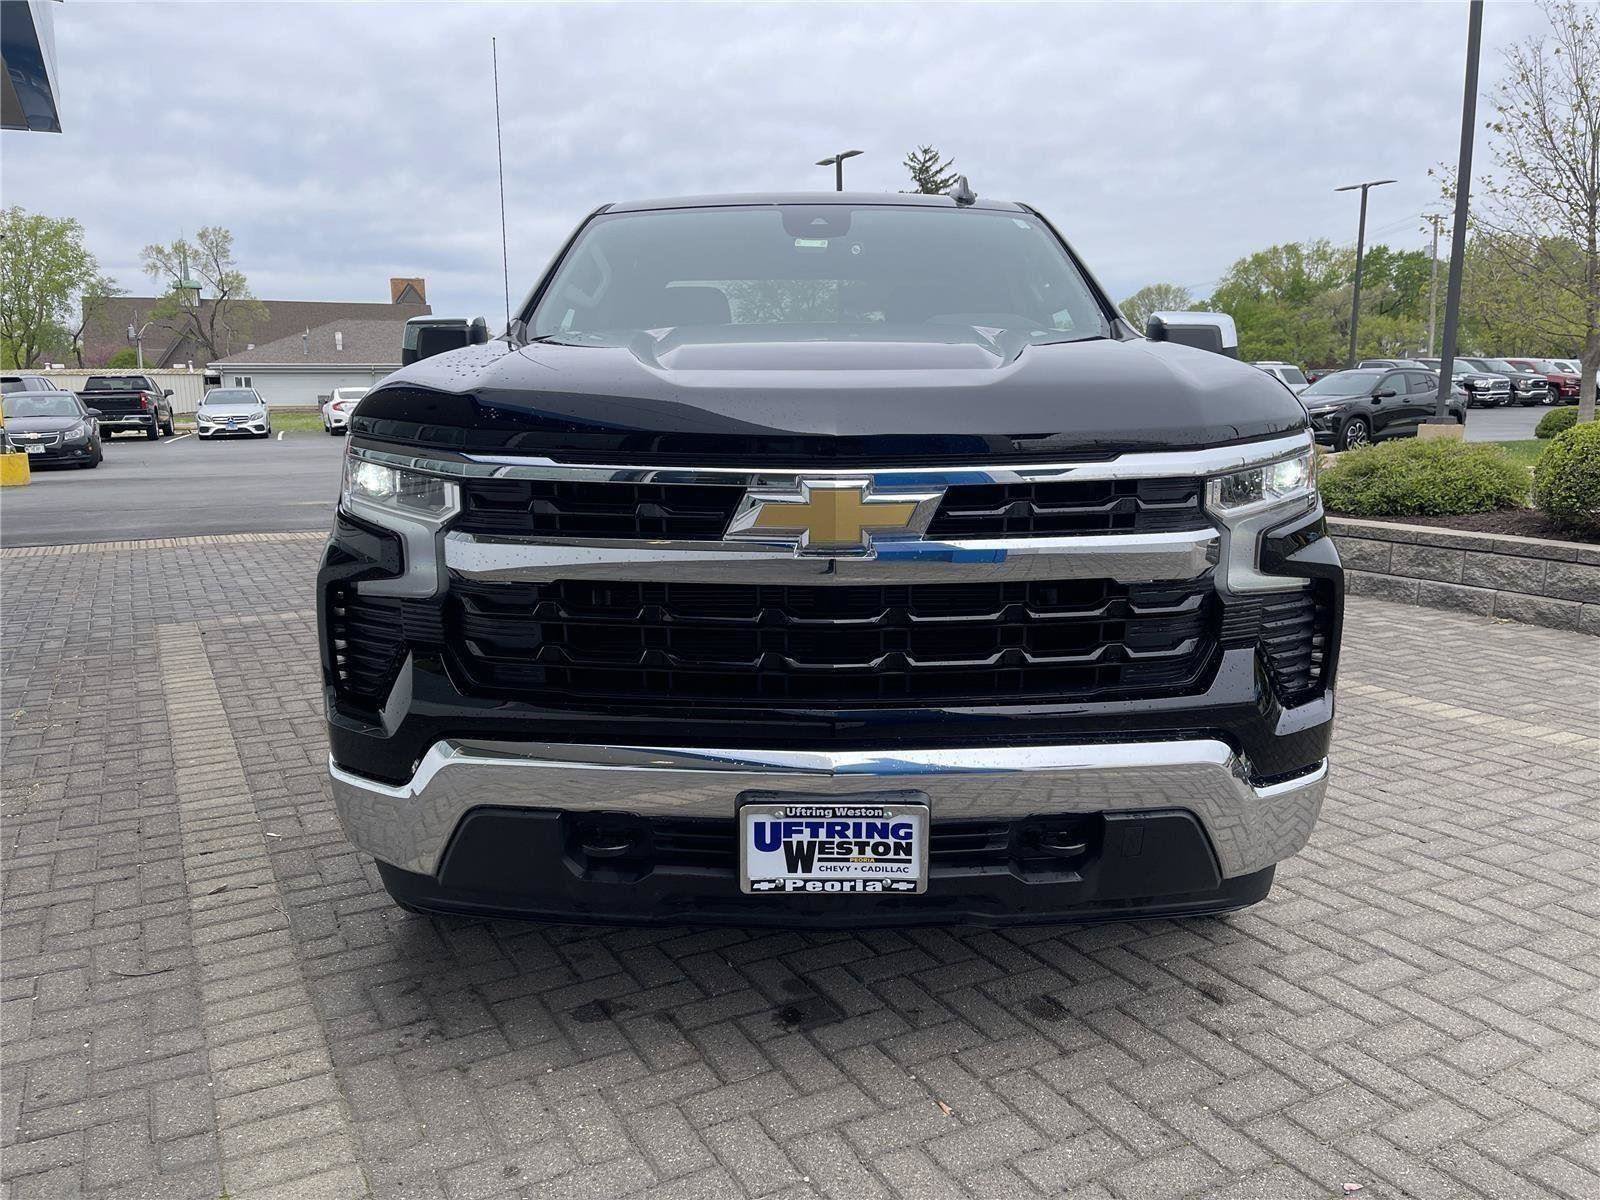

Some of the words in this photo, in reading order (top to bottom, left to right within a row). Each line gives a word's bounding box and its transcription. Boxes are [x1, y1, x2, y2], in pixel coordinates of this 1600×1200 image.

[786, 807, 833, 818] Uftring
[835, 807, 883, 817] Weston
[753, 821, 913, 853] UFTRING
[783, 840, 913, 874] WESTON
[819, 865, 851, 873] CHEVY
[861, 865, 910, 874] CADILLAC
[785, 880, 883, 892] Peoria
